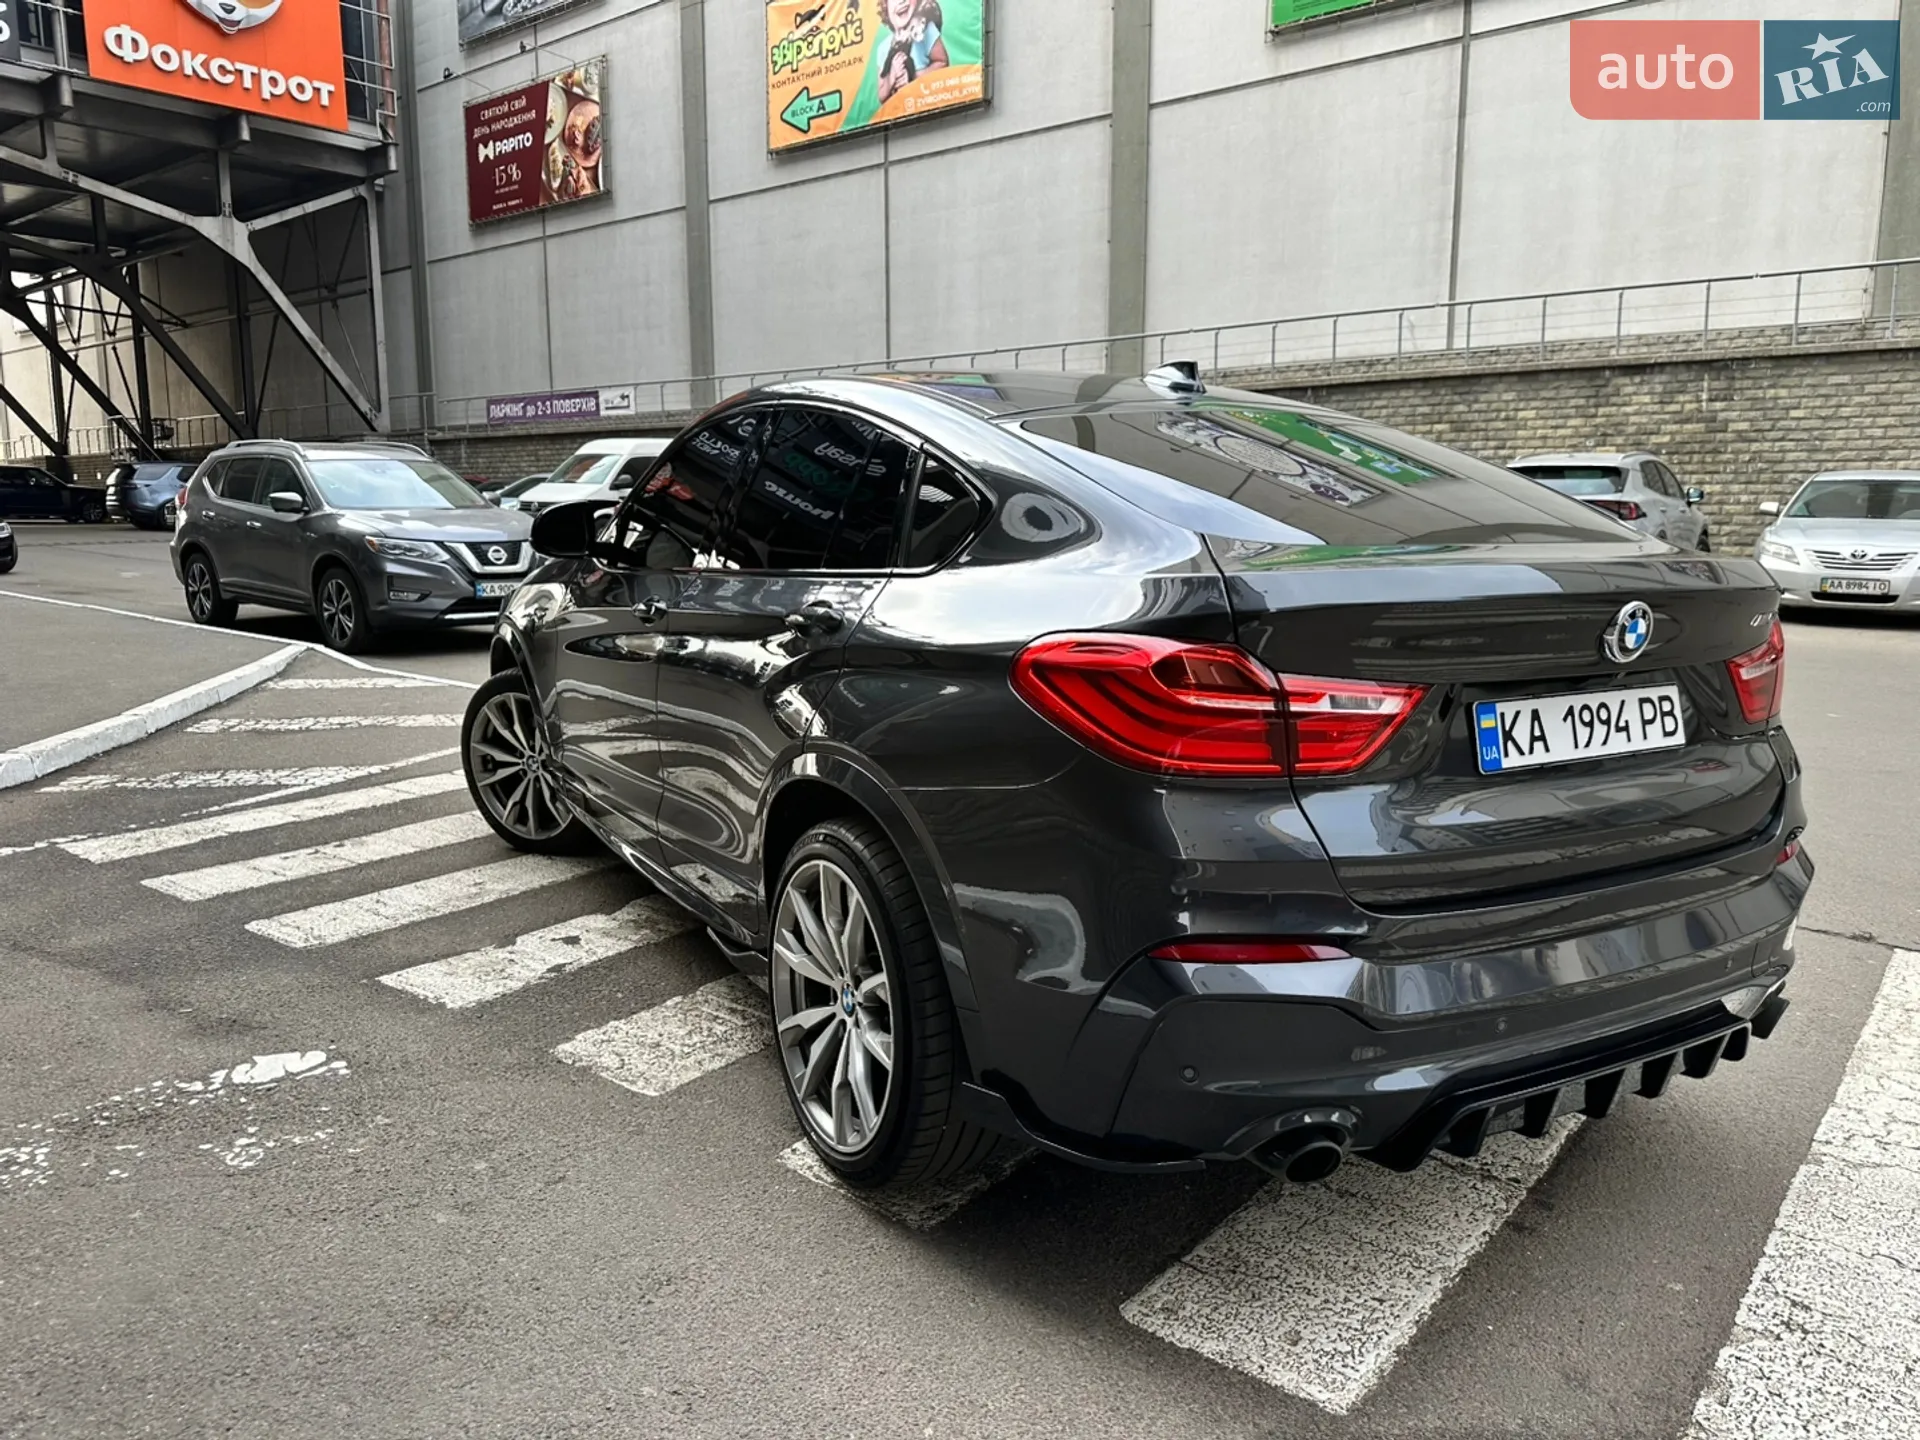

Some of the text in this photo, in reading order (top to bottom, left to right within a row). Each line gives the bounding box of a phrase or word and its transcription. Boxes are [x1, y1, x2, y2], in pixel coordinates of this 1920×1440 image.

[104, 24, 335, 107] Фокстрот
[771, 56, 864, 90] КОНТАКТНИЙ ЗООПАРК
[791, 99, 827, 119] BLOCK A
[491, 110, 536, 132] НАРОДЖЕННЯ
[495, 132, 533, 156] PAPITO
[552, 397, 596, 414] ПОВЕРХІВ
[1828, 580, 1844, 590] AA
[1845, 580, 1869, 590] 8984
[1500, 695, 1679, 758] KA 1994 PB
[1483, 746, 1499, 761] UA
